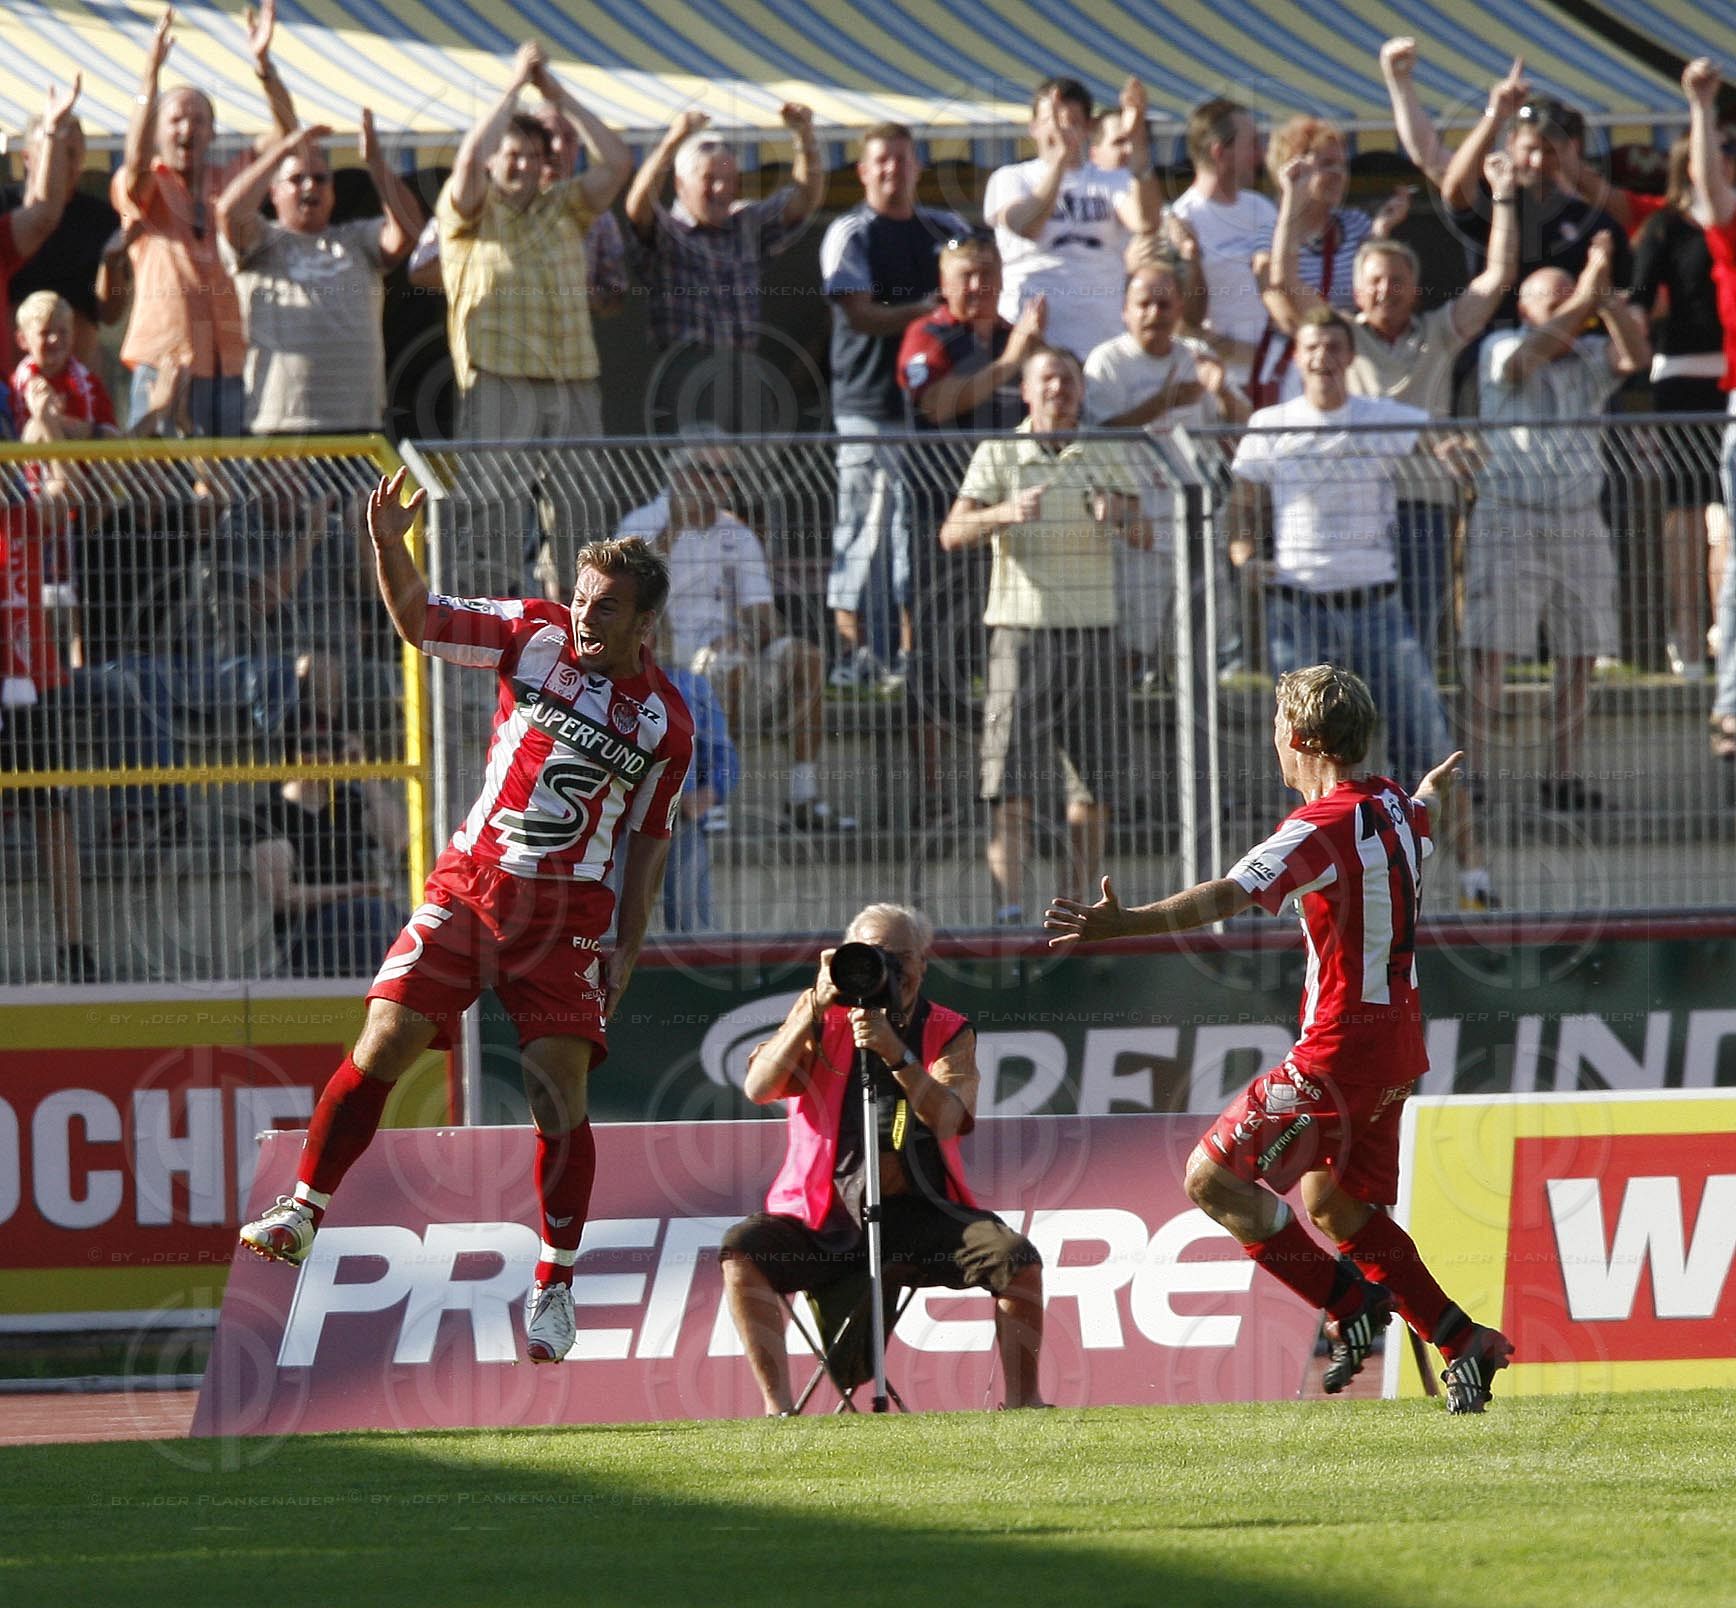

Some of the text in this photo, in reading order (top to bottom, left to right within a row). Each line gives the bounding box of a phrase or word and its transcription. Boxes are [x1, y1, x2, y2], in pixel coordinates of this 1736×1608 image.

[518, 692, 646, 775] SUPERFUND
[572, 936, 602, 953] FUC
[1256, 1112, 1312, 1172] SUPERFUND
[277, 1207, 1256, 1368] PREMERE
[1546, 1174, 1736, 1321] W
